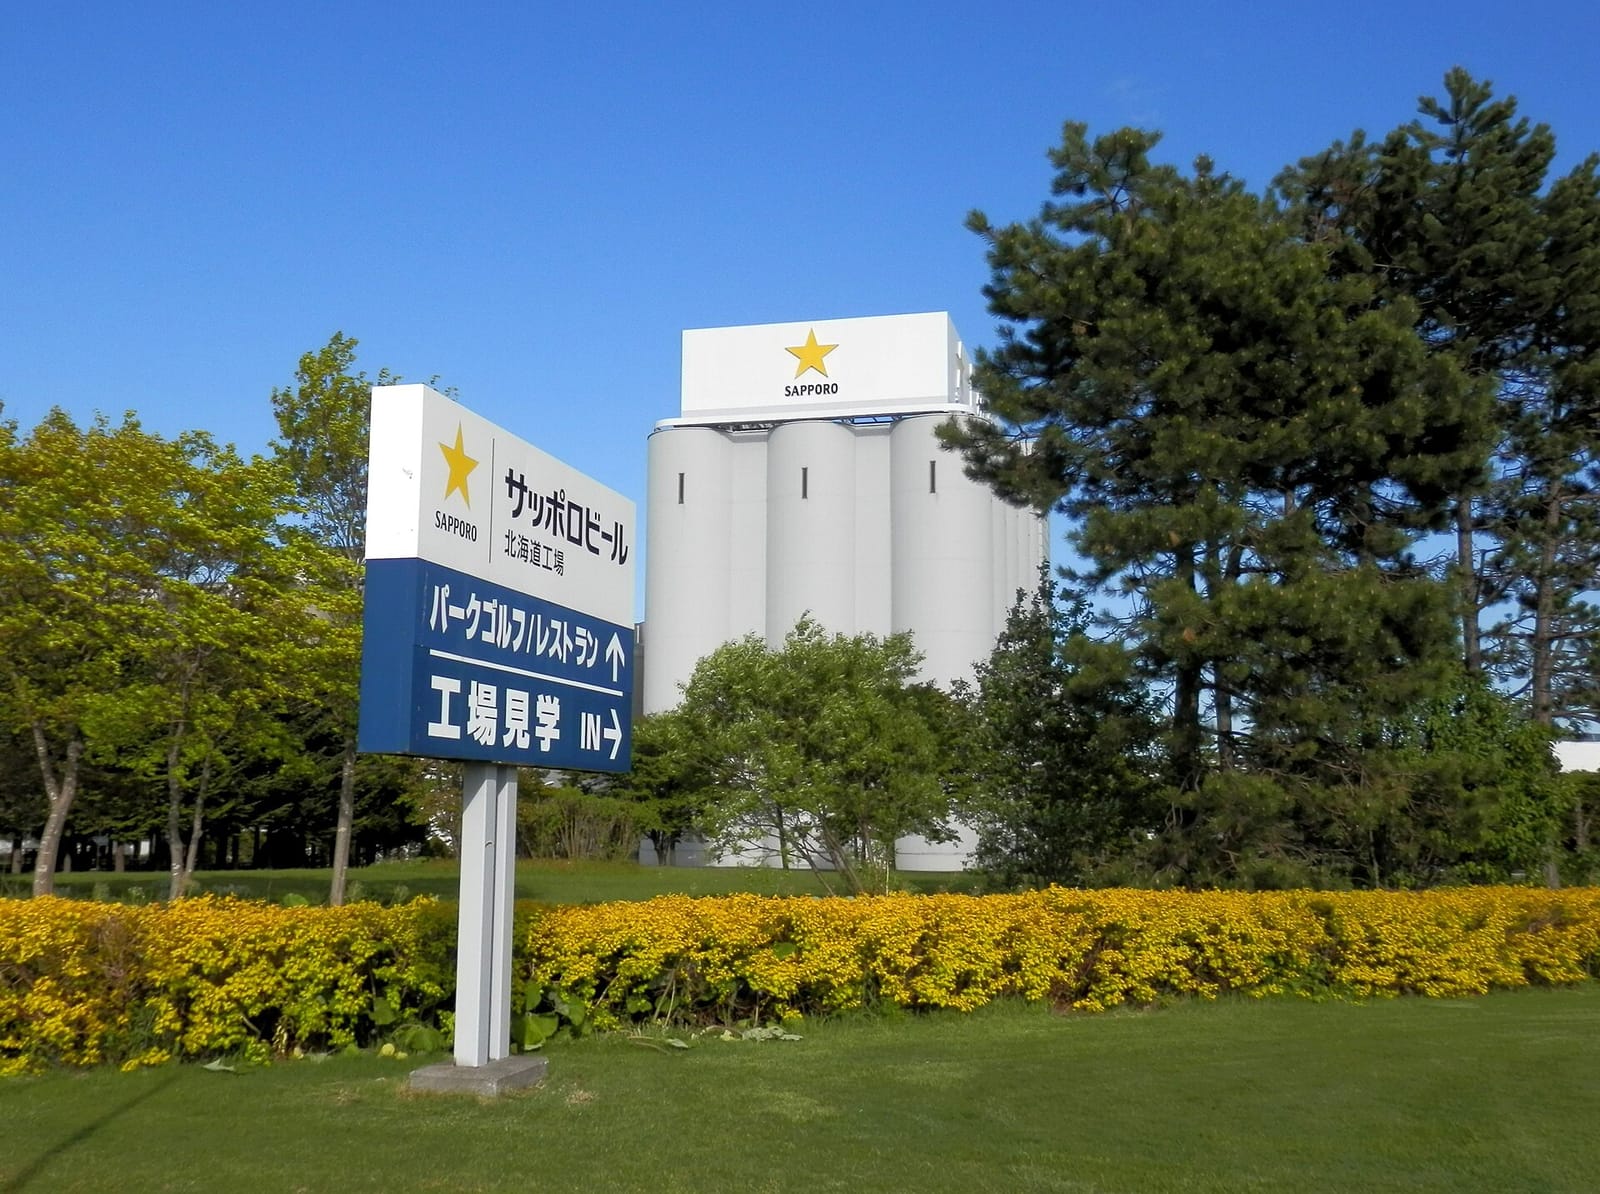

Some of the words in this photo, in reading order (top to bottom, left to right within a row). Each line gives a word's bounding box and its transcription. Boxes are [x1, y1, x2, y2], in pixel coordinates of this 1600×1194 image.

[784, 383, 838, 397] SAPPORO
[434, 510, 477, 542] SAPPORO
[505, 467, 628, 565] サッポロビール
[504, 529, 564, 576] 北海道工場
[428, 675, 560, 752] 工場見学
[580, 711, 601, 751] IN
